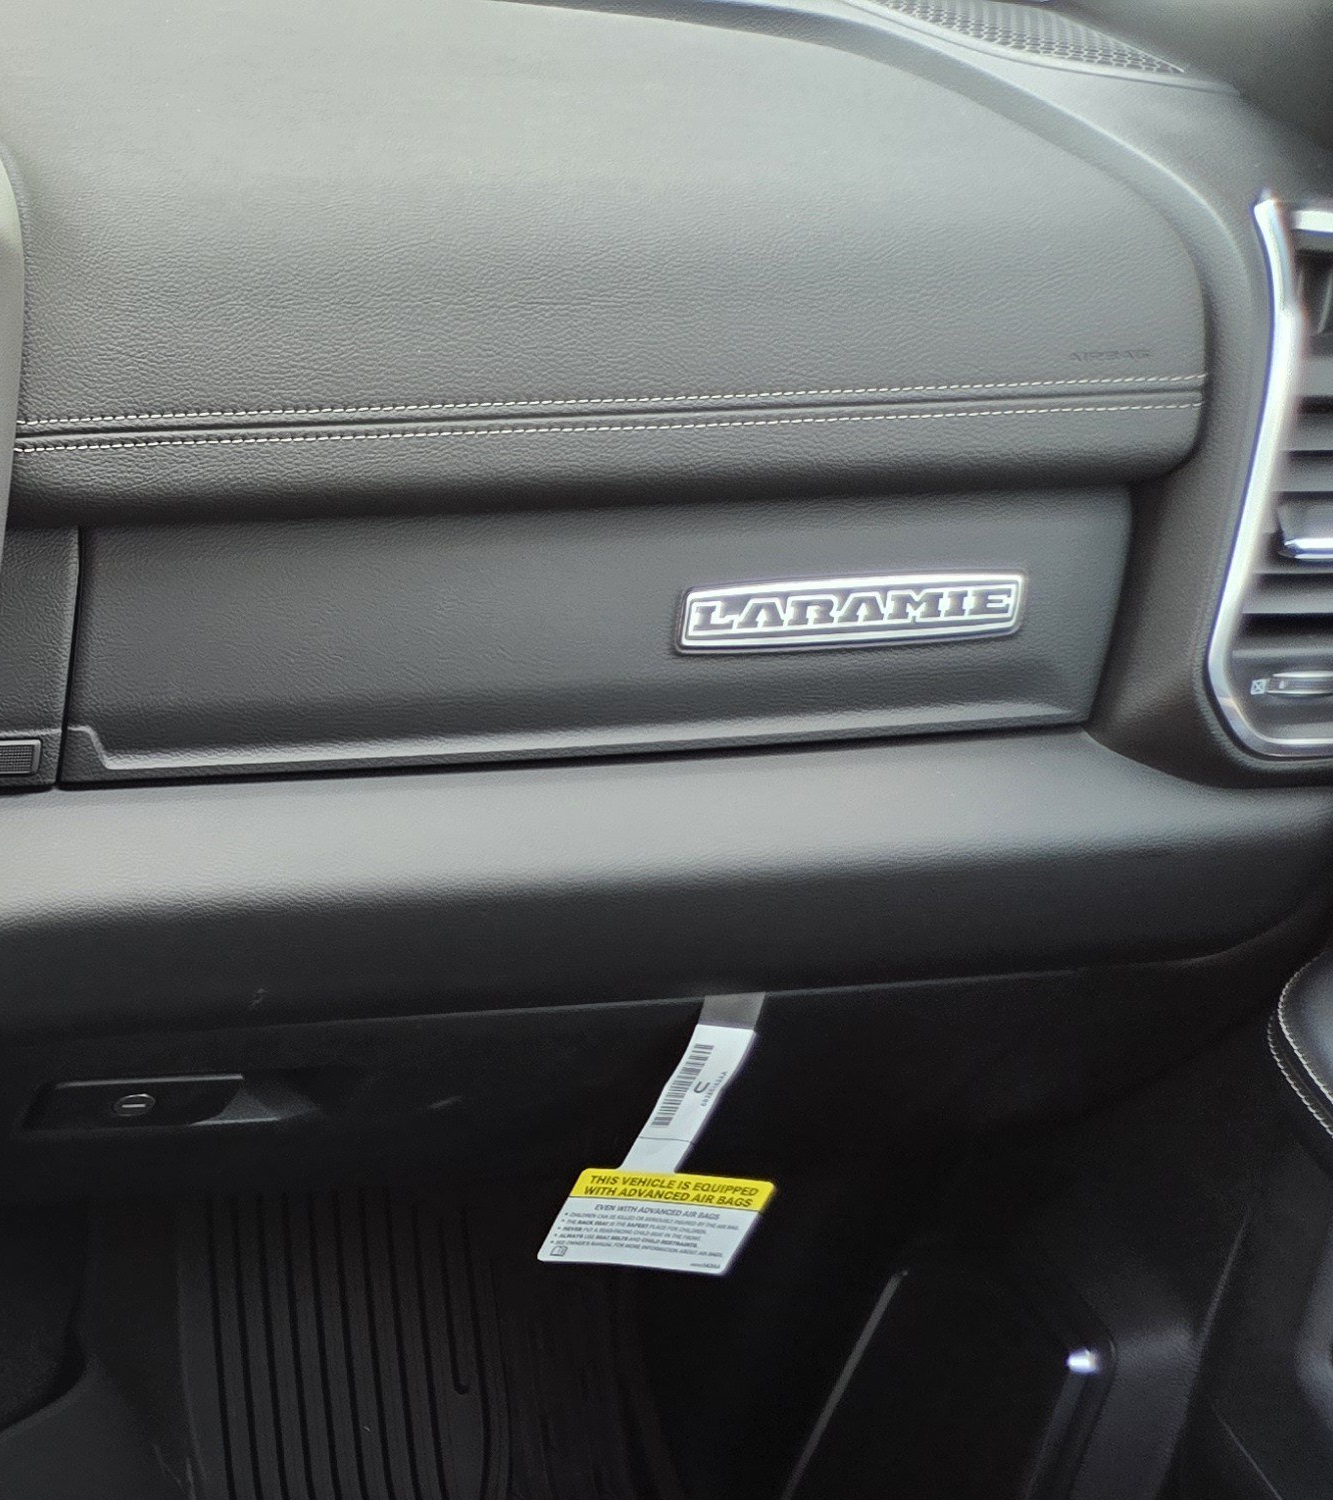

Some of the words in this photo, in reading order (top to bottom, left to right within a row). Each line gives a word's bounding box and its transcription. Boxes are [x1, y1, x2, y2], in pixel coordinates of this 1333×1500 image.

[690, 586, 1014, 634] LARAMIE
[583, 1186, 618, 1197] WITH
[617, 1187, 691, 1202] ADVANCED
[690, 1193, 715, 1204] AIR
[716, 1195, 754, 1208] BAGS
[590, 1175, 620, 1185] THIS
[621, 1176, 676, 1189] VEHICLE
[677, 1180, 692, 1190] IS
[692, 1182, 760, 1197] EQUIPPED
[594, 1203, 616, 1212] EVEN
[616, 1204, 639, 1213] WITH
[637, 1206, 683, 1217] ADVANCED
[682, 1210, 697, 1218] AIR
[697, 1212, 721, 1220] BAGS
